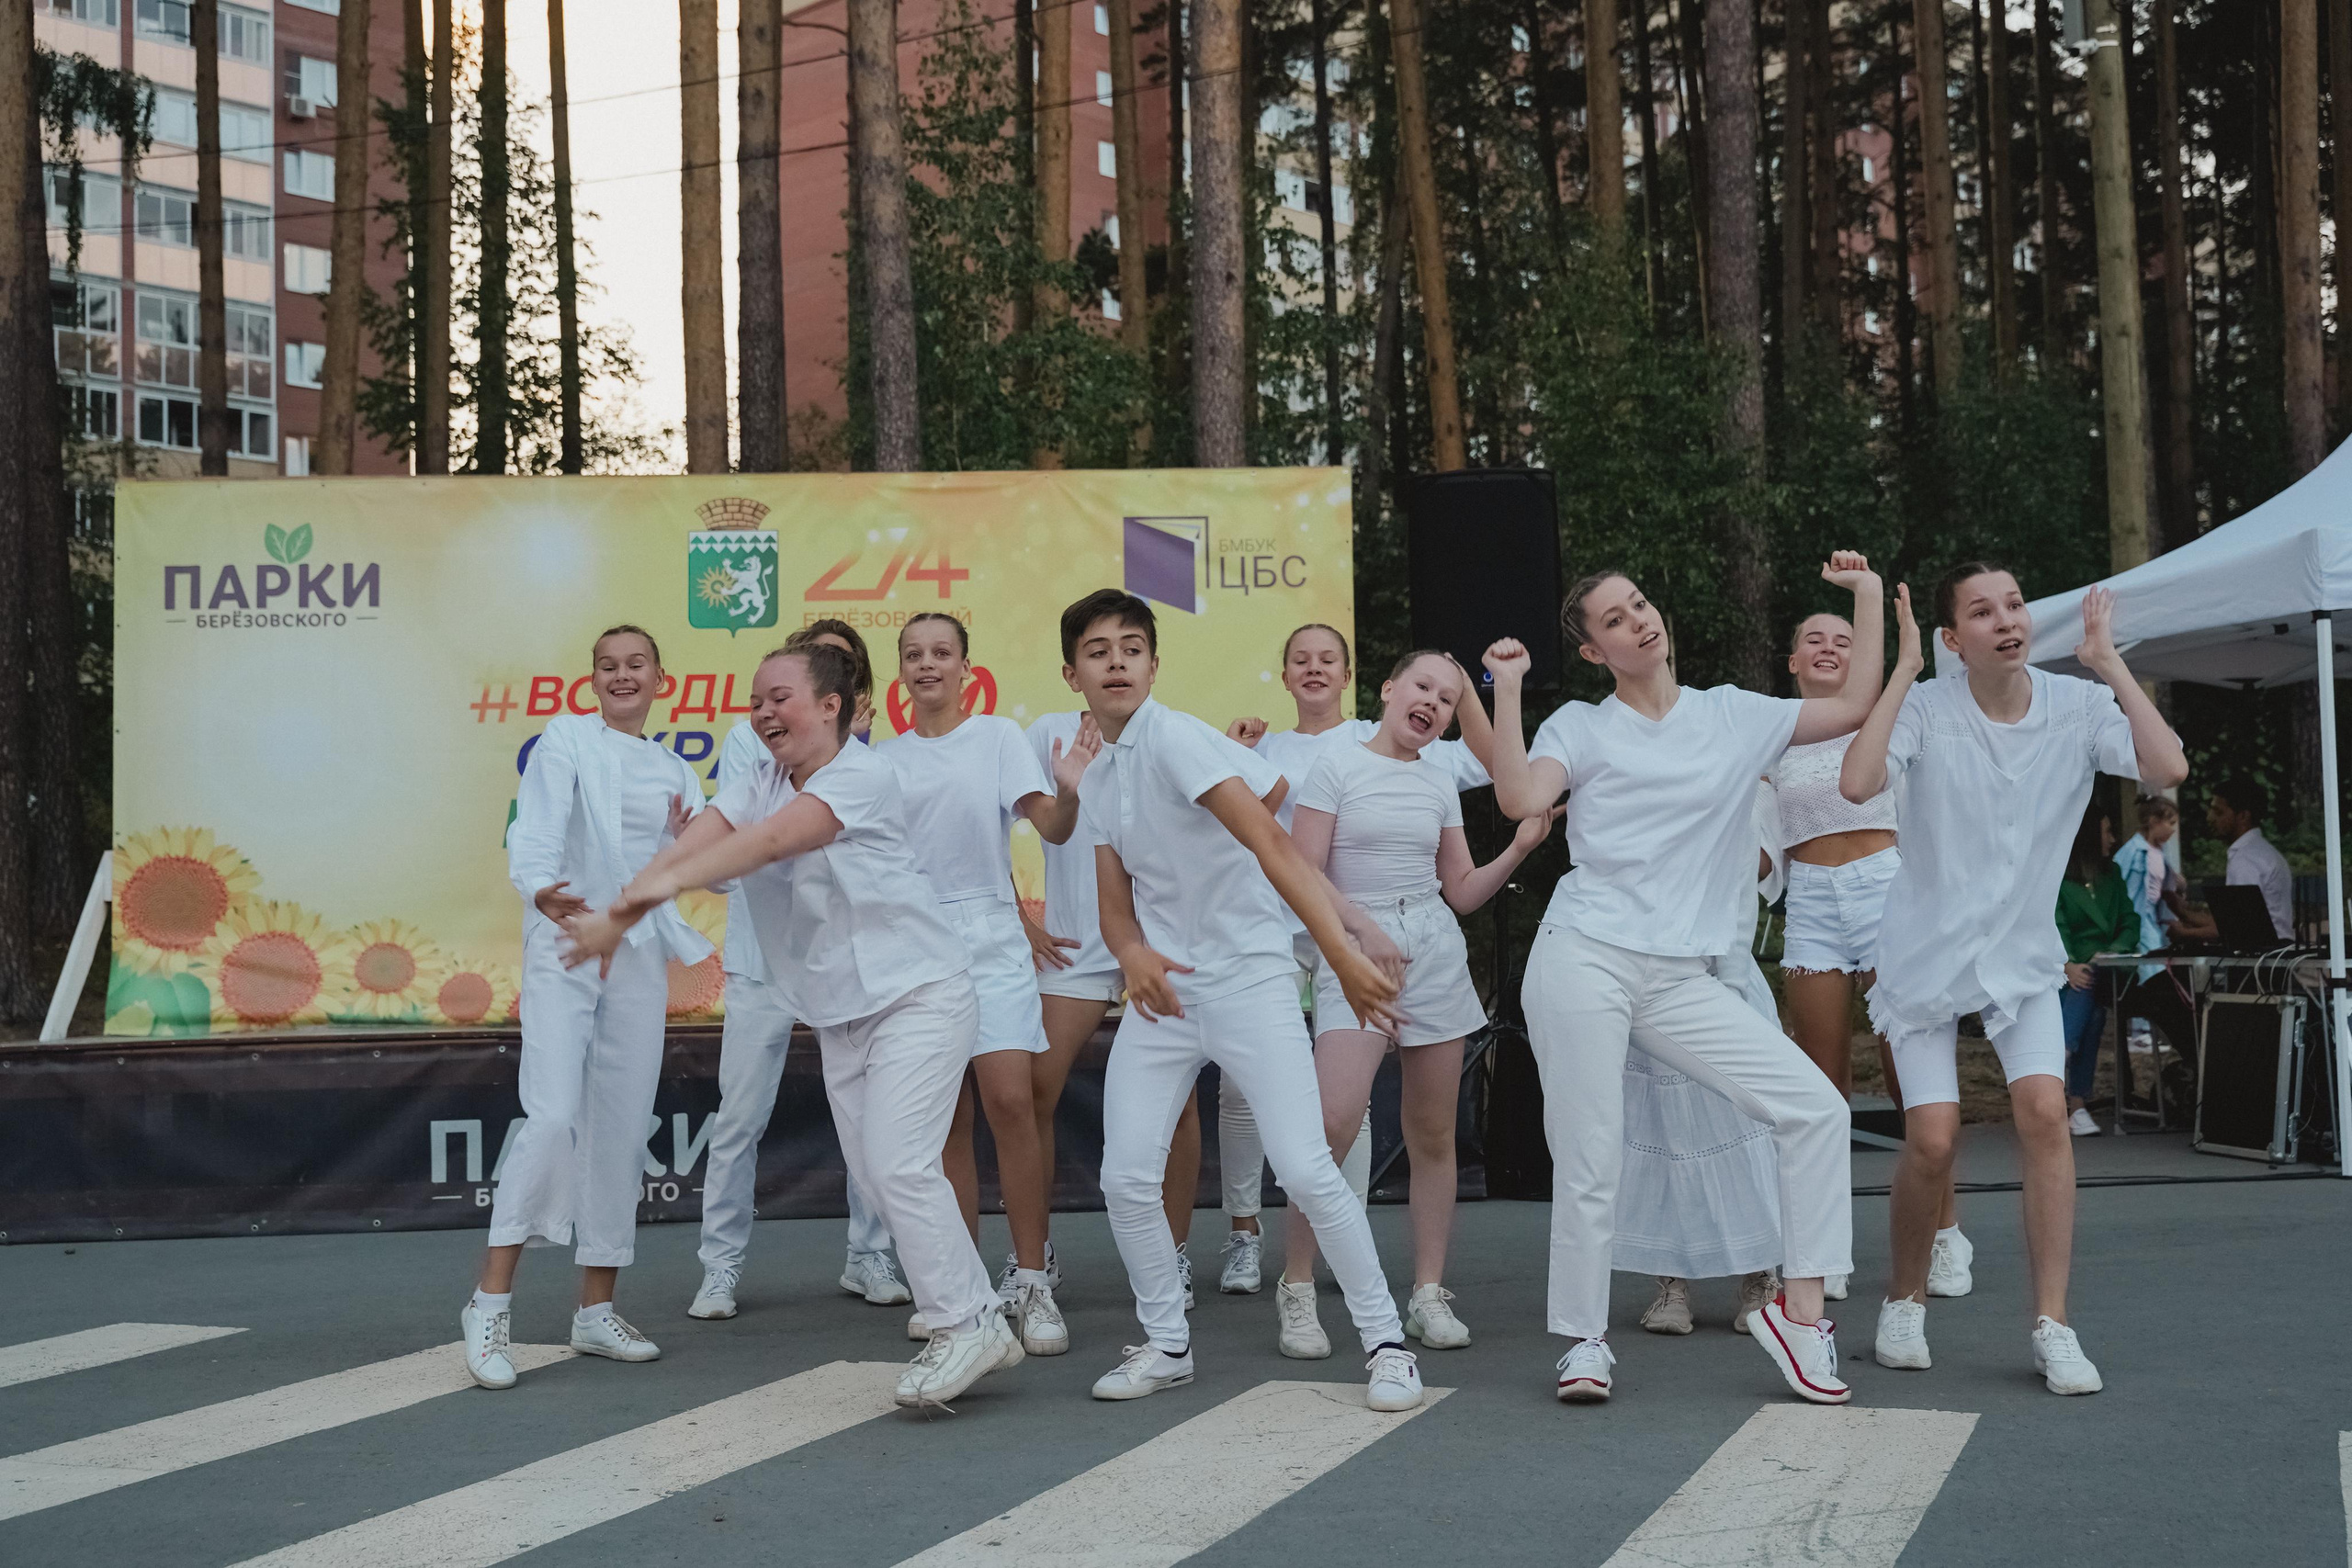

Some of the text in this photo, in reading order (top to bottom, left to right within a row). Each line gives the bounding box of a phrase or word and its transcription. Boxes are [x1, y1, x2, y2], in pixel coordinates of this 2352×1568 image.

[1218, 537, 1277, 553] БМБУК
[164, 561, 381, 611] ПАРКИ
[1219, 554, 1307, 597] ЦБС
[195, 610, 348, 629] БЕРЁЗОВСКОГО
[802, 605, 972, 630] БРЁЗОВЙ
[429, 1111, 719, 1184] ПКИ
